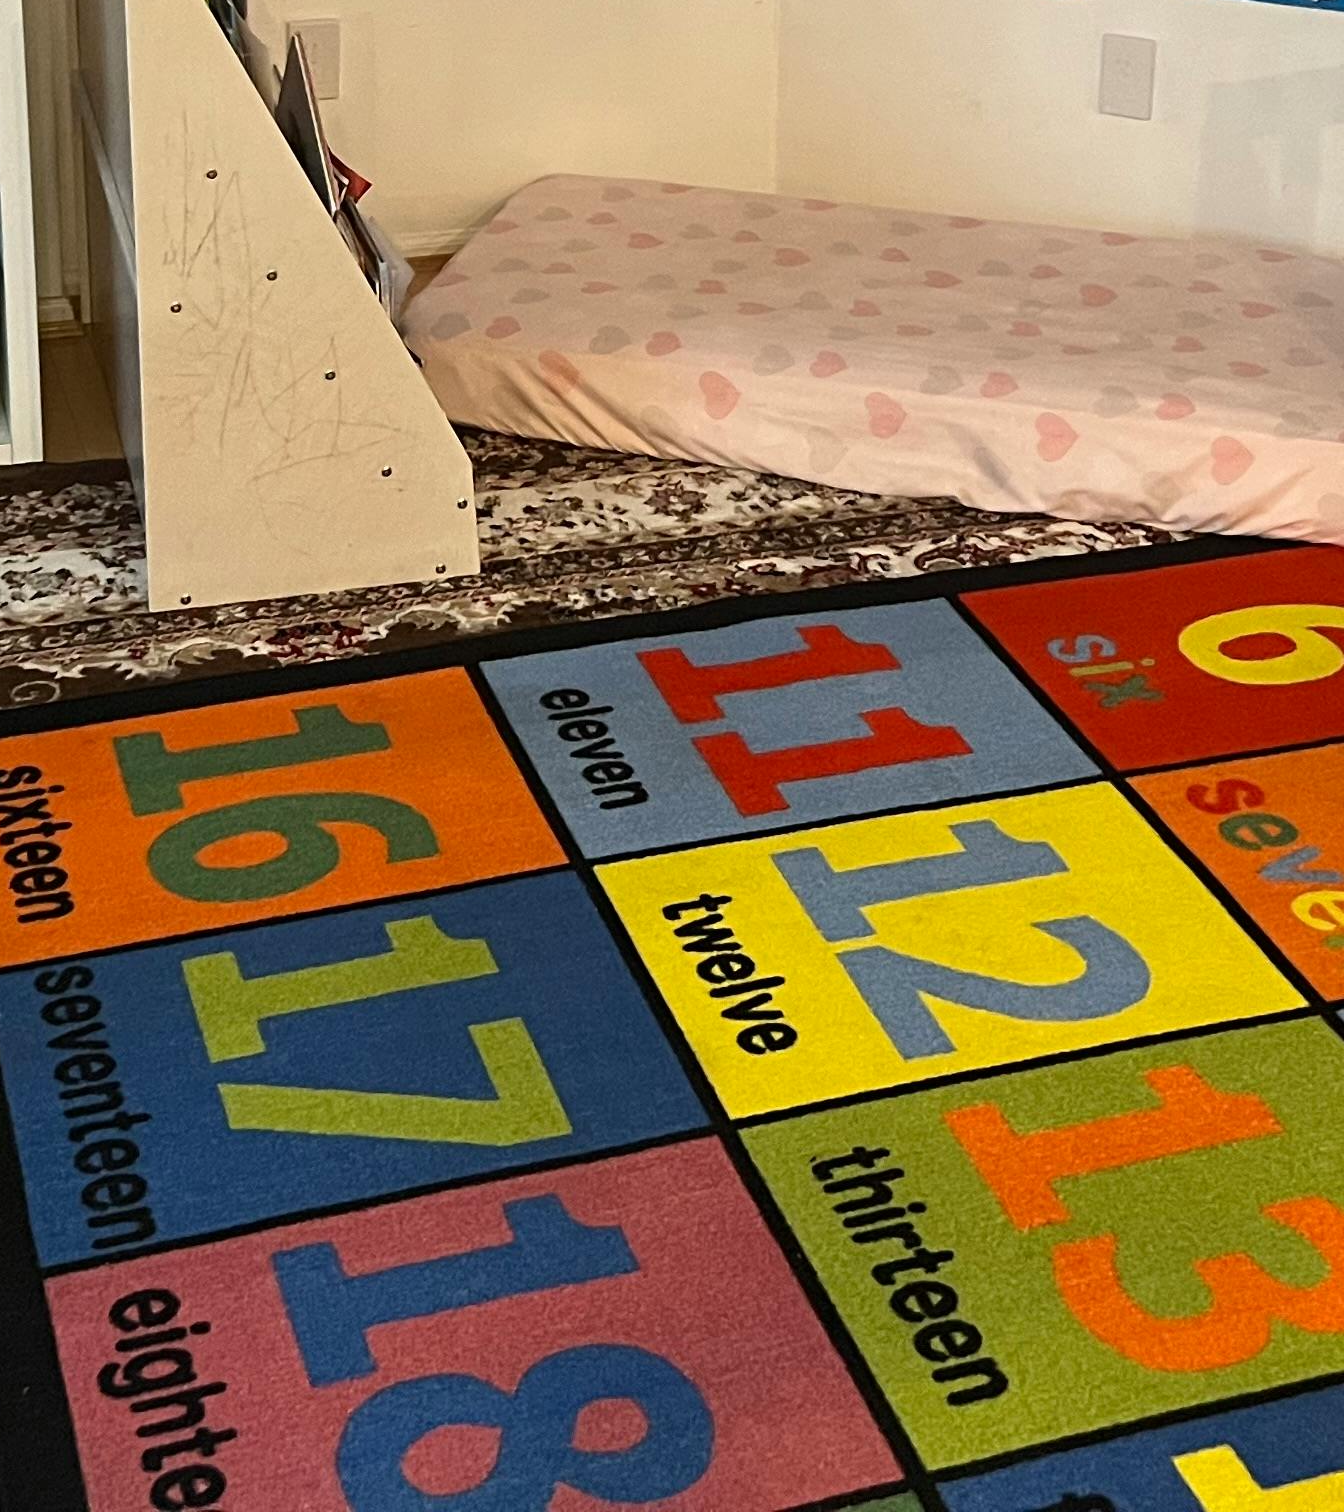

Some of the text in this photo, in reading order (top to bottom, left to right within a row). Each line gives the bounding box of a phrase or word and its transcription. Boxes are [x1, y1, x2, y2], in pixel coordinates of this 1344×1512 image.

[538, 686, 650, 810] eleven
[635, 624, 974, 818] 11
[1046, 634, 1162, 708] six
[112, 703, 441, 904] 16
[180, 914, 574, 1148] 17
[661, 892, 799, 1057] twelve
[770, 818, 1153, 1064] 12
[32, 963, 159, 1251] seventeen
[270, 1191, 716, 1512] 18
[809, 1145, 1010, 1408] thirteen
